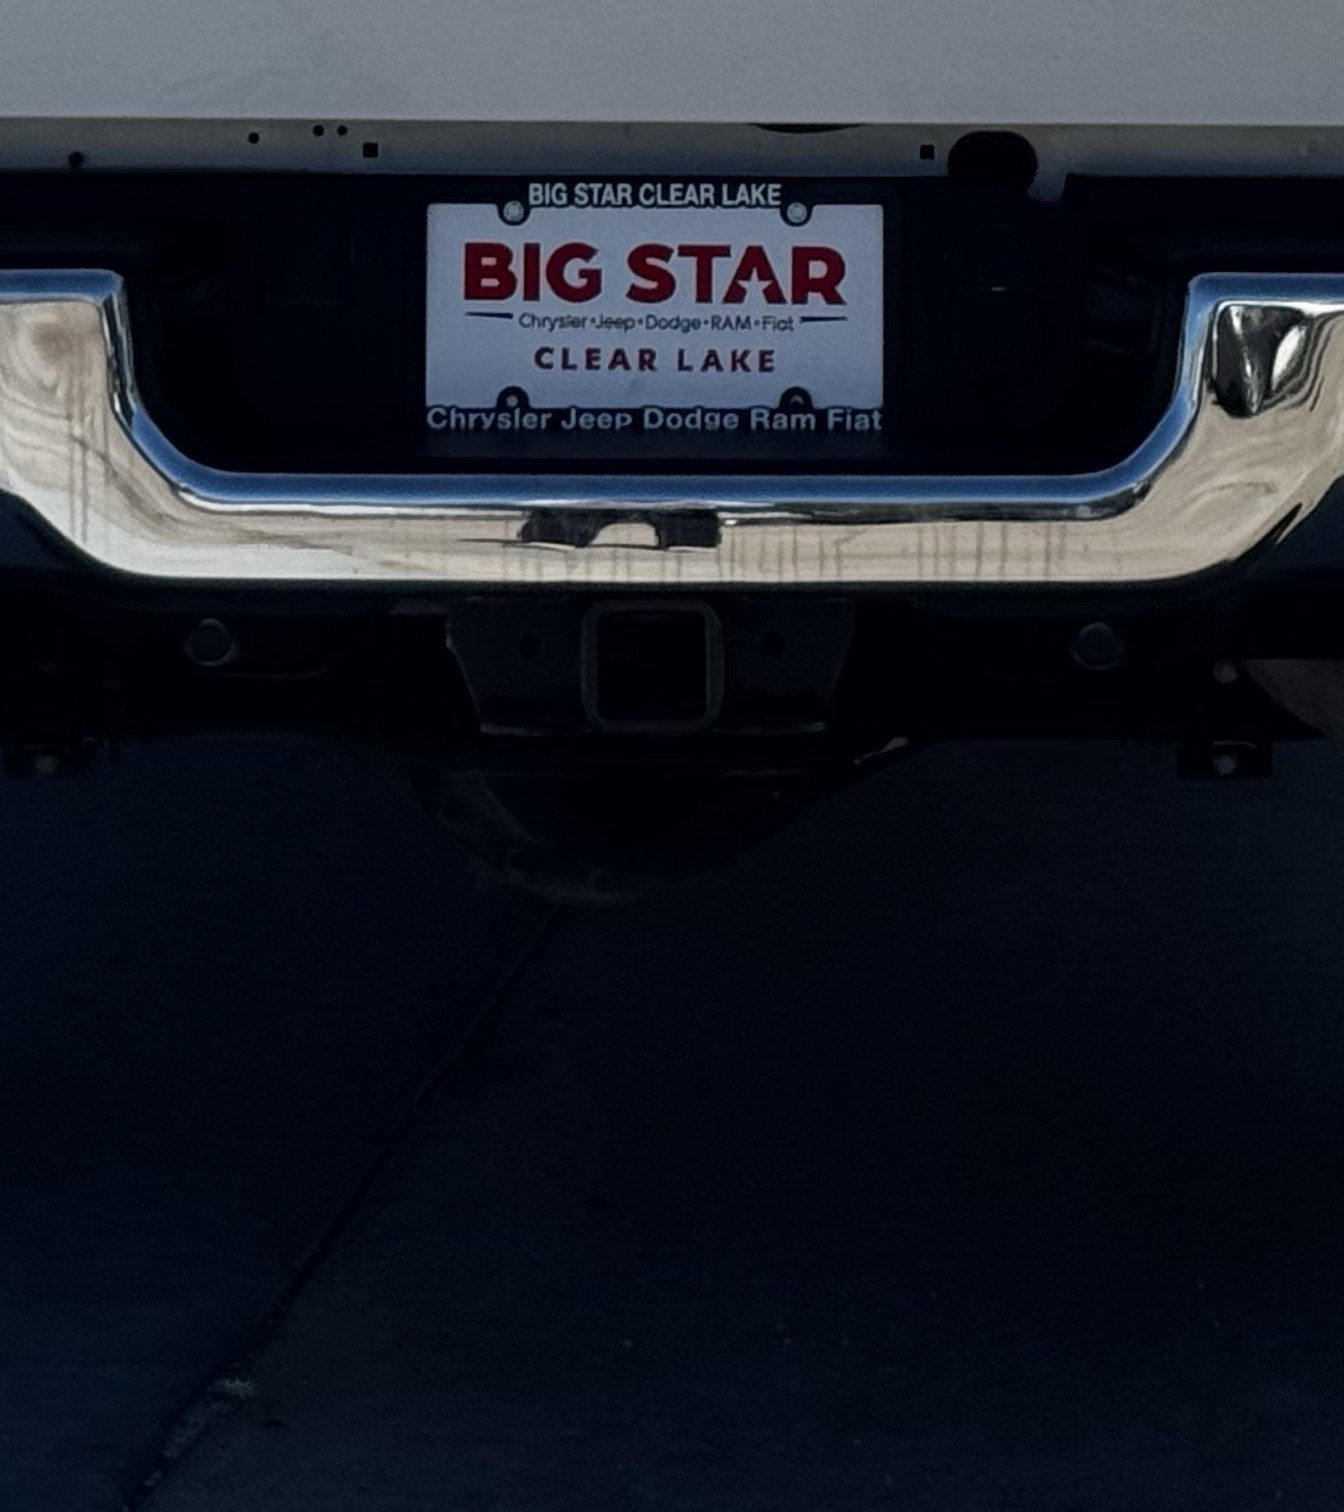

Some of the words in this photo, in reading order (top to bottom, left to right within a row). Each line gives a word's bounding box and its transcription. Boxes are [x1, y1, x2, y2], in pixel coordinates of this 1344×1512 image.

[528, 182, 568, 206] BIG
[573, 182, 634, 206] STAR
[638, 183, 716, 207] CLEAR
[721, 184, 782, 207] LAKE
[463, 242, 603, 303] BIG
[625, 244, 848, 306] STAR
[533, 346, 658, 372] CLEAR
[677, 348, 777, 373] LAKE
[425, 407, 553, 433] Chrysler
[560, 407, 633, 433] Jeep
[643, 407, 739, 433] Dodge
[749, 409, 817, 431] Ram
[827, 408, 883, 431] Fiat
